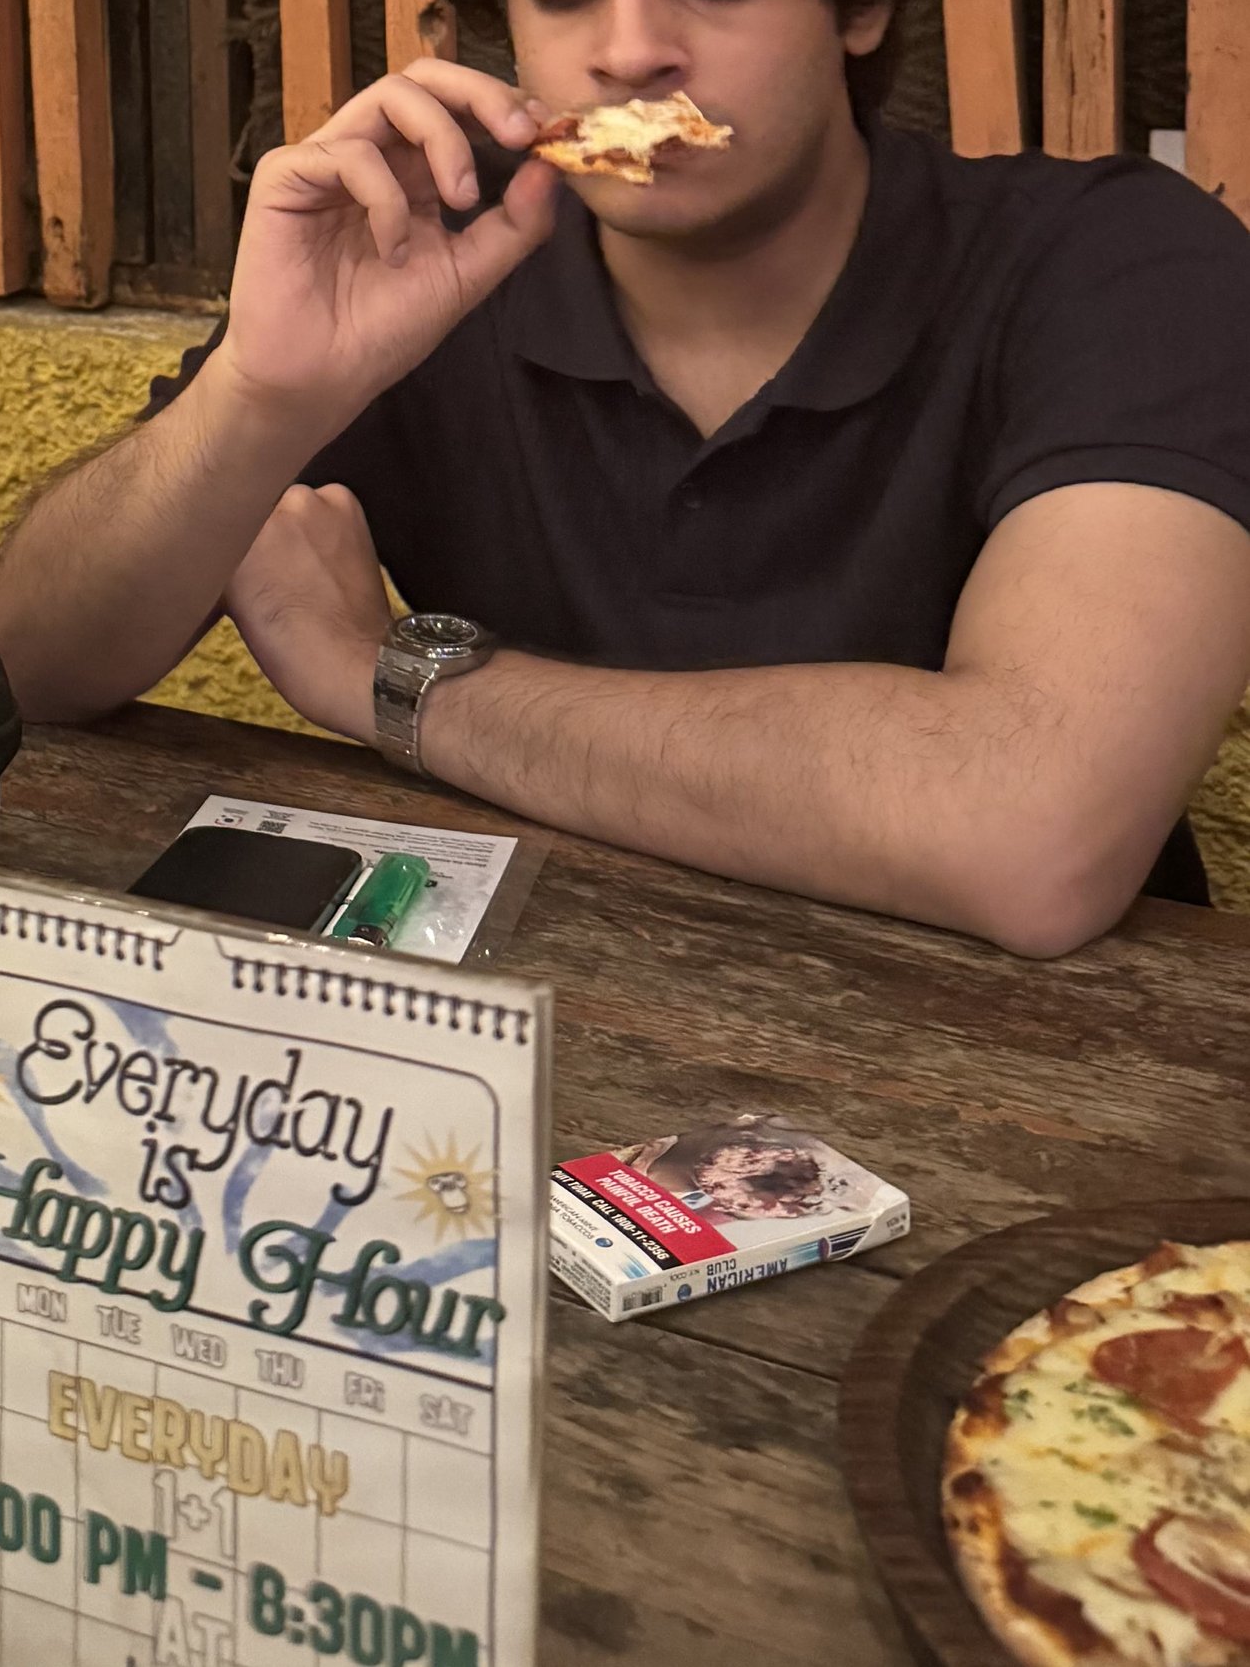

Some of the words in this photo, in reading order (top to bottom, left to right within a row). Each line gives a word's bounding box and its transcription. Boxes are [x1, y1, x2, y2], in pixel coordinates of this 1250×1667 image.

[17, 999, 394, 1206] Everyday
[140, 1121, 197, 1210] is
[595, 1176, 643, 1208] PAINFUL
[635, 1205, 679, 1234] DEATH
[608, 1169, 662, 1201] TOBACCO
[654, 1200, 702, 1234] CAUSES
[551, 1169, 571, 1183] QUIT
[568, 1179, 596, 1199] TODAY
[591, 1199, 616, 1215] CALL
[611, 1213, 670, 1260] 1800-11-2356
[239, 1220, 506, 1358] Hour
[706, 1258, 737, 1276] CLUB
[707, 1258, 788, 1294] AMERICAN
[17, 1282, 67, 1323] MON
[97, 1305, 141, 1344] TUE
[170, 1323, 227, 1369] WED
[255, 1349, 305, 1389] THU
[419, 1393, 476, 1435] SAT
[48, 1369, 350, 1517] EVERYDAY
[84, 1508, 168, 1603] PM
[152, 1467, 237, 1561] 1+1
